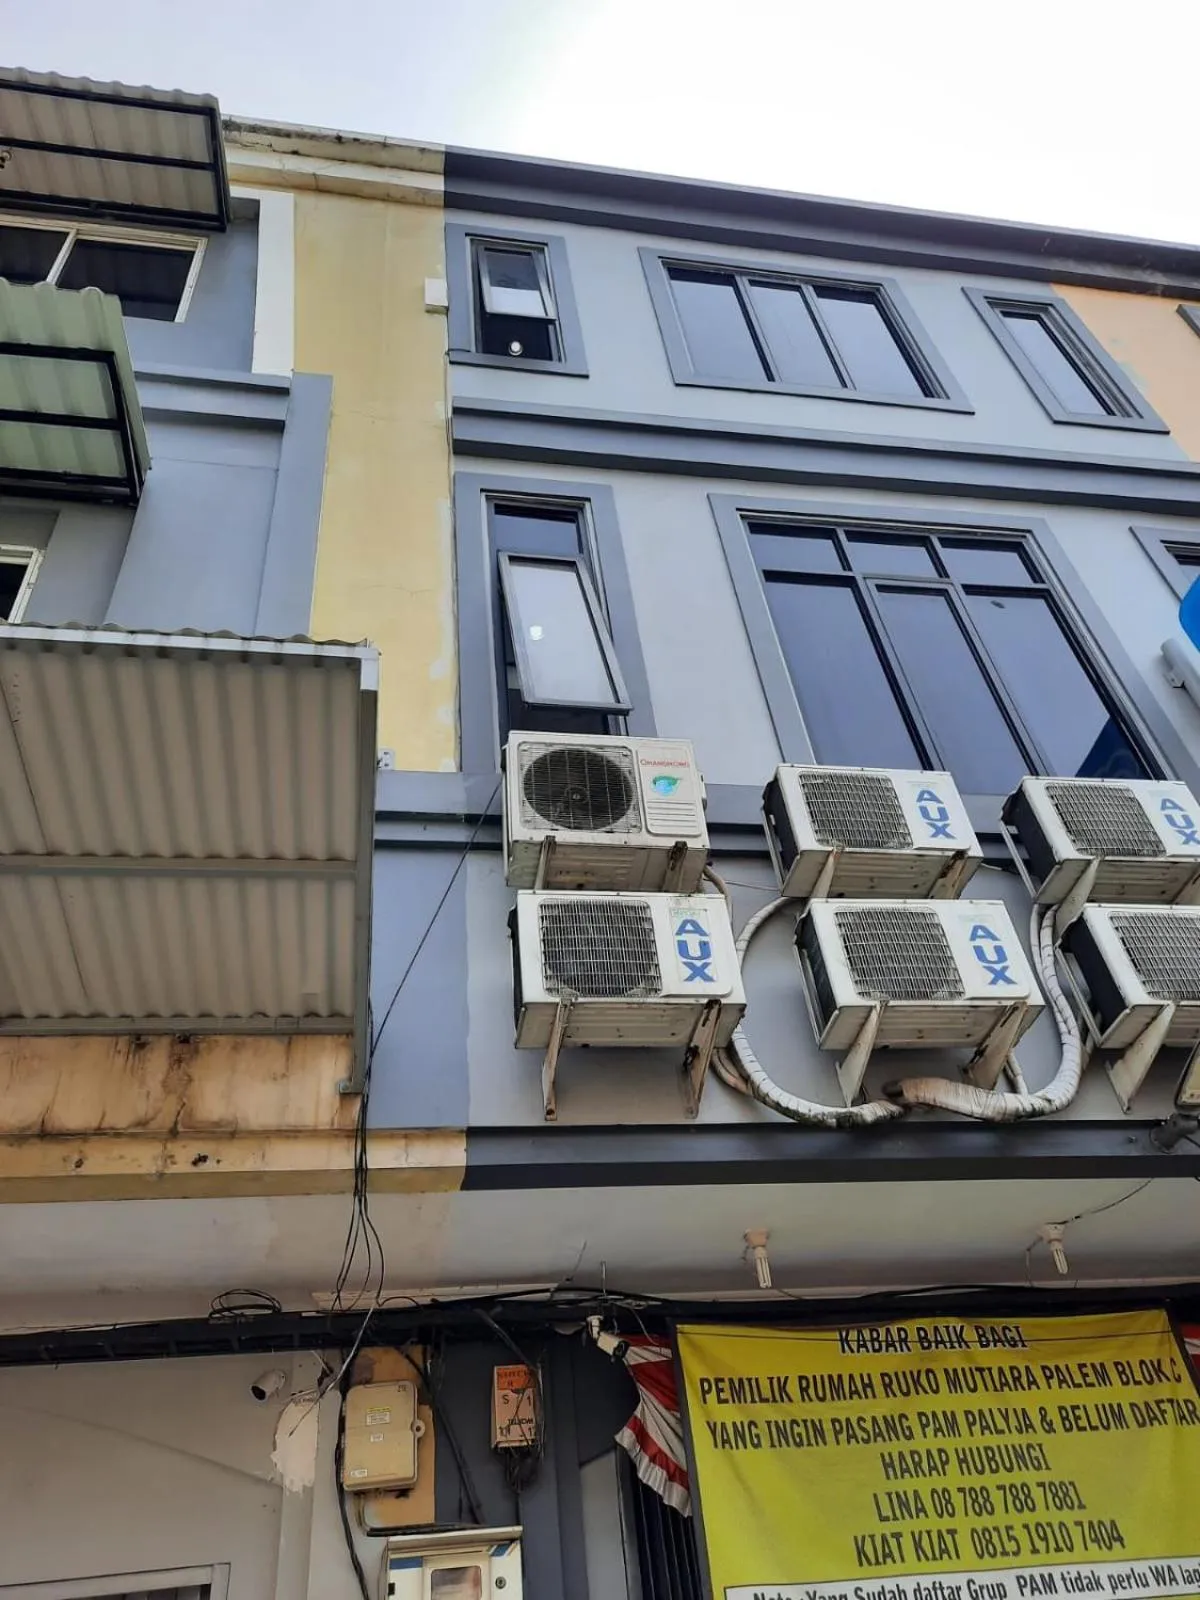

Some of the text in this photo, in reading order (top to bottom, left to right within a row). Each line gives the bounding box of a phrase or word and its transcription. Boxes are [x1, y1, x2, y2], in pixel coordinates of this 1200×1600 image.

[916, 789, 957, 839] AUX
[1160, 798, 1200, 845] AUX
[675, 919, 716, 982] AUX
[969, 924, 1017, 985] AUX
[837, 1325, 1028, 1354] KABAR BAIK BAGI
[699, 1357, 1182, 1405] PEMILIK RUMAH RUKO MUTIARA PALEM BLOK C
[706, 1397, 1200, 1450] YANG INGIN PASANG PAM PALYJA & BELUM DAFTAR
[880, 1443, 1052, 1481] HARAP HUBUNGI
[873, 1480, 1087, 1522] LINA 08 788 788 7881
[853, 1519, 1126, 1568] KIAT KIAT 0815 1910 7404
[913, 1580, 962, 1600] daftar
[966, 1578, 1008, 1600] Grup
[1016, 1572, 1058, 1597] PAM
[1060, 1569, 1105, 1594] tidak
[1107, 1567, 1150, 1595] perlu
[1148, 1564, 1179, 1587] WA
